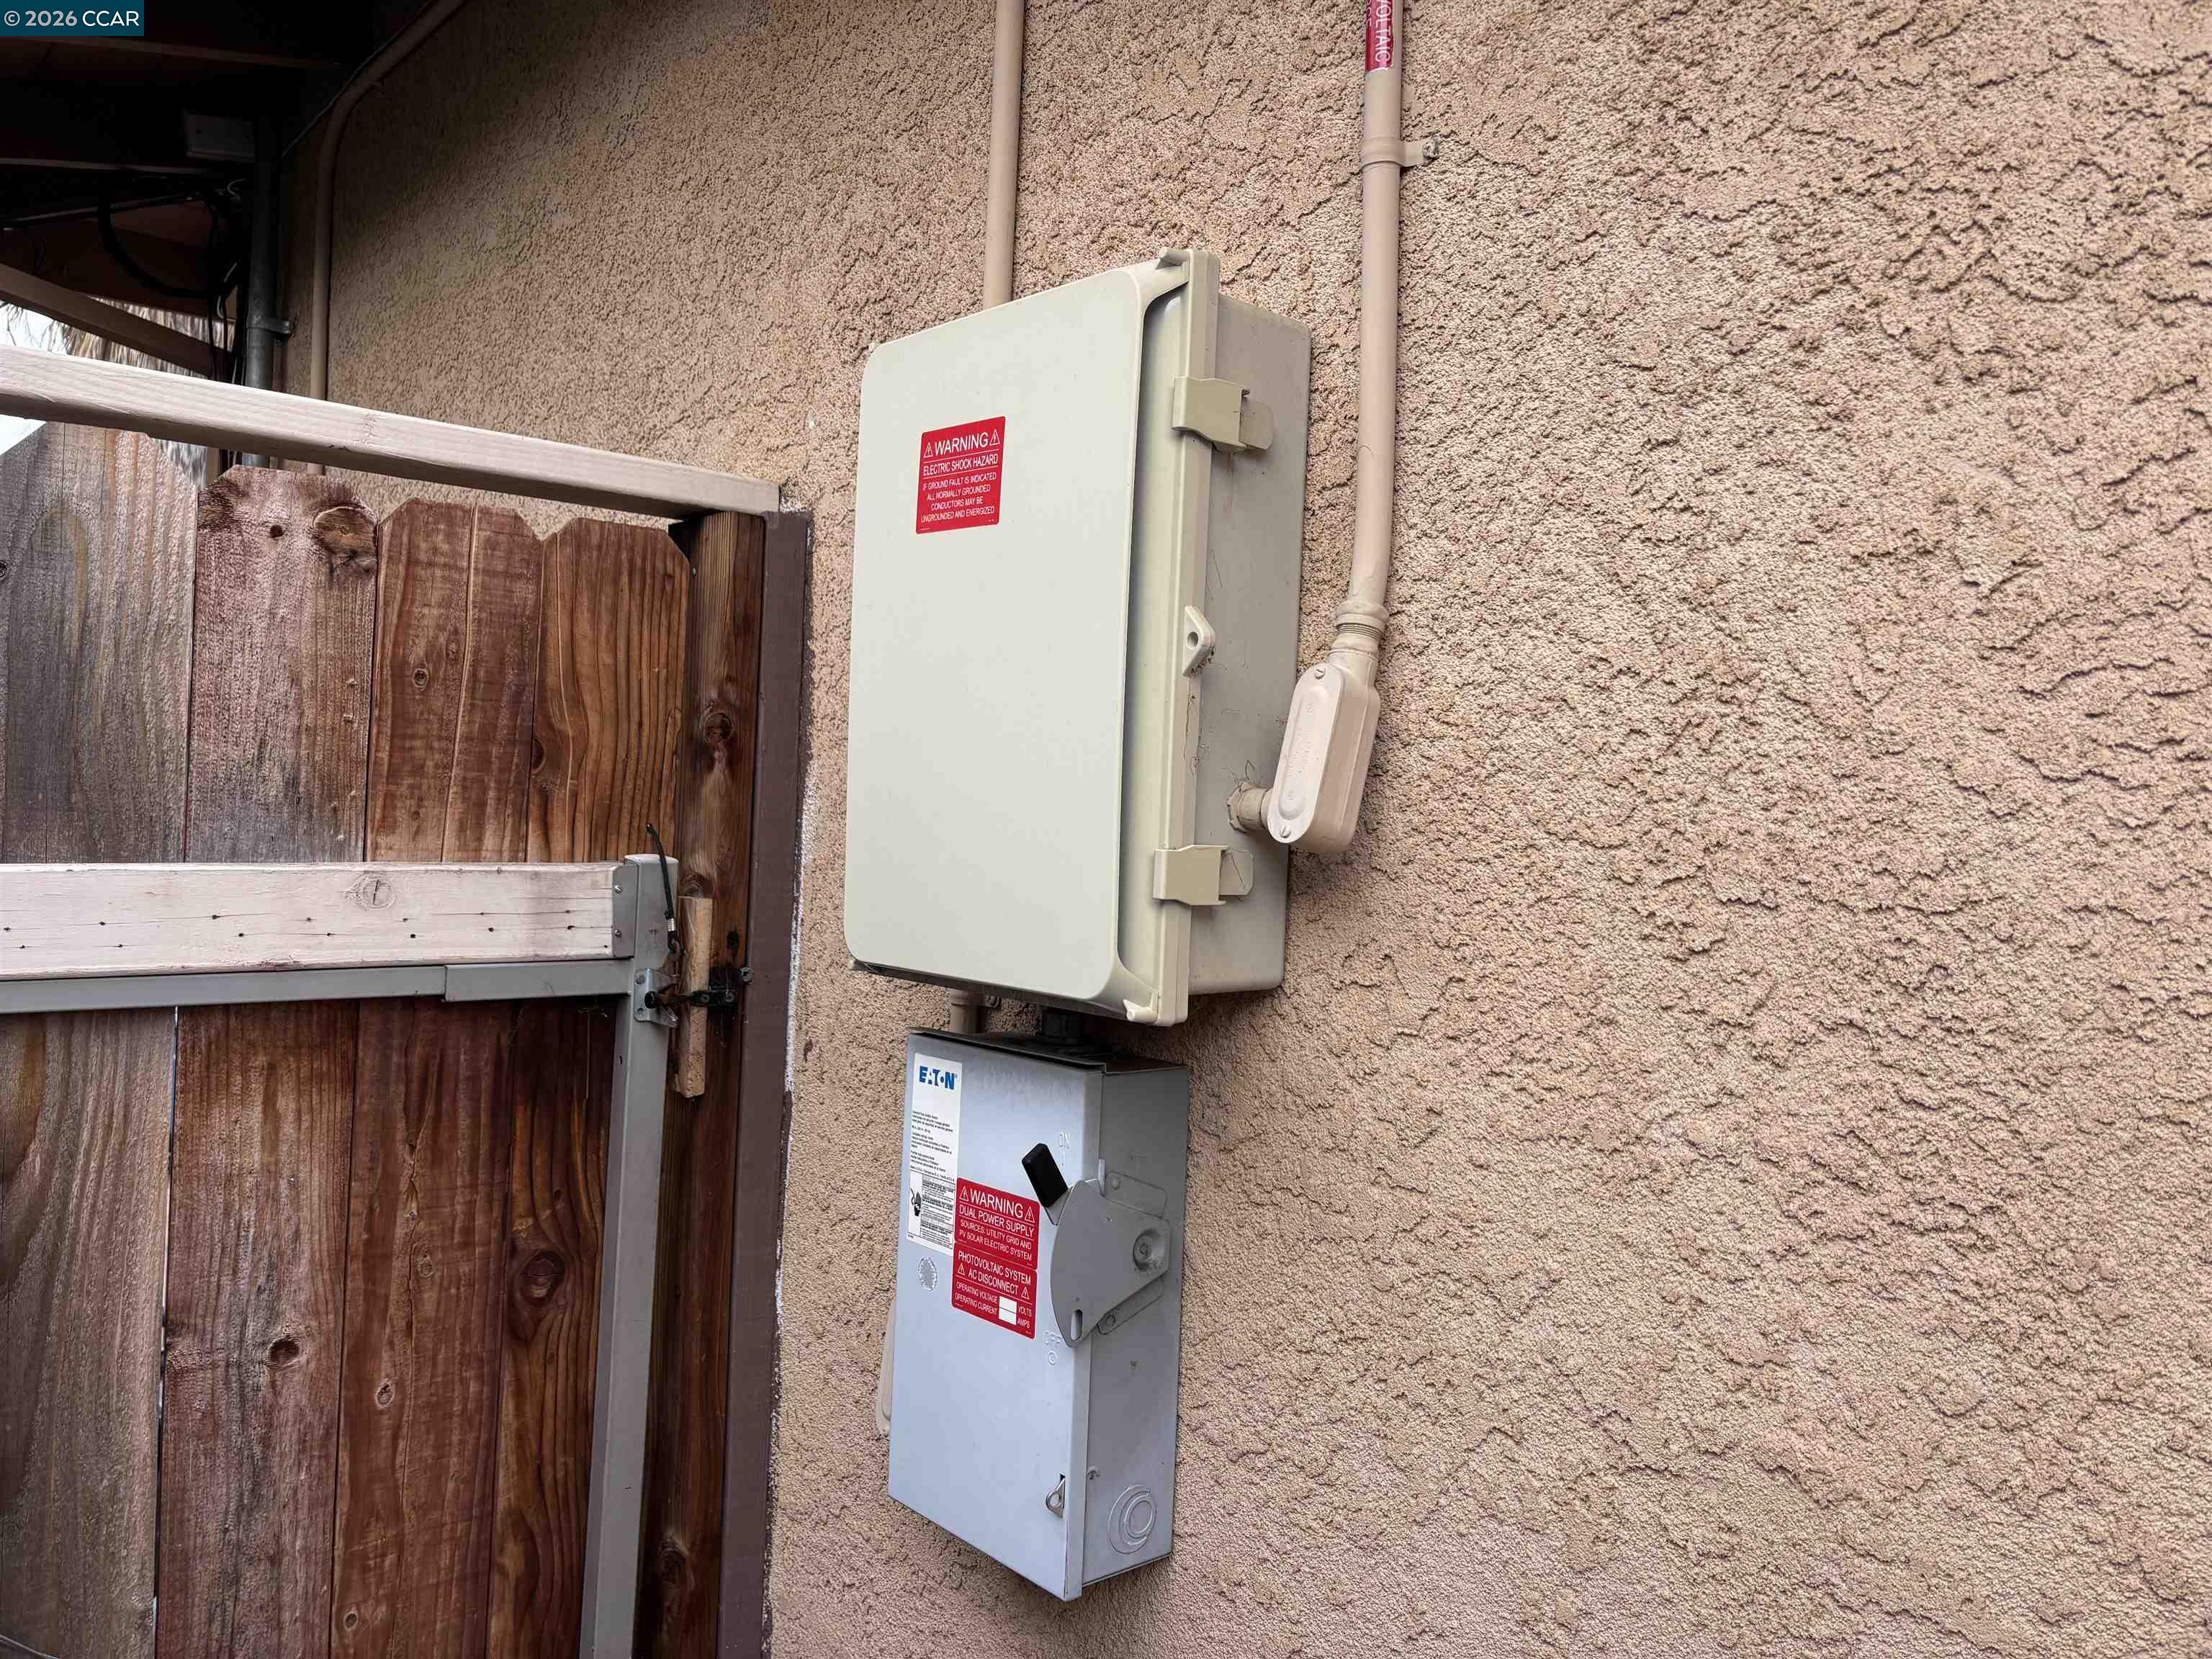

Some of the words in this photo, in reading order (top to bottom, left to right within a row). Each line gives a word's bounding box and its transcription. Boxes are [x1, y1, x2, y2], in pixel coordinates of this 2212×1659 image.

[935, 432, 989, 455] WARNING
[923, 463, 950, 476] ELECTRIC
[951, 458, 972, 472] SHOCK
[973, 454, 998, 467] HAZARD
[922, 482, 928, 491] IF
[928, 480, 948, 490] GROUND
[949, 477, 963, 487] FAULT
[971, 472, 997, 483] INDICATED
[927, 493, 936, 501] ALL
[937, 488, 962, 500] NORMALLY
[962, 484, 991, 495] GROUNDED
[922, 511, 954, 523] UNGROUNDED
[955, 509, 965, 518] AND
[966, 505, 994, 517] ENERGIZED
[931, 499, 964, 511] CONDUCTORS
[965, 497, 975, 506] MAY
[976, 495, 983, 505] BE
[919, 1066, 955, 1090] EATON
[970, 1188, 1023, 1218] WARNING
[959, 1205, 977, 1219] DUAL
[979, 1210, 1004, 1228] POWER
[1006, 1220, 1034, 1238] SUPPLY
[961, 1219, 986, 1233] SOURCES:
[986, 1227, 1006, 1241] UTILITY
[1007, 1235, 1020, 1246] GRID
[1020, 1240, 1032, 1250] AND
[966, 1232, 983, 1244] SOLAR
[984, 1237, 1010, 1253] ELECTRIC
[1010, 1247, 1032, 1262] SYSTEM
[958, 1251, 1004, 1276] PHOTOVOLTAIC
[1004, 1267, 1031, 1286] SYSTEM
[968, 1269, 977, 1280] AC
[979, 1272, 1019, 1295] DISCONNECT
[956, 1282, 979, 1297] OPERATING
[979, 1290, 998, 1304] VOLTAGE
[1018, 1306, 1032, 1317] VOLTS
[956, 1292, 977, 1308] OPERATING
[978, 1302, 997, 1315] CURRENT
[1017, 1318, 1030, 1328] AMPS
